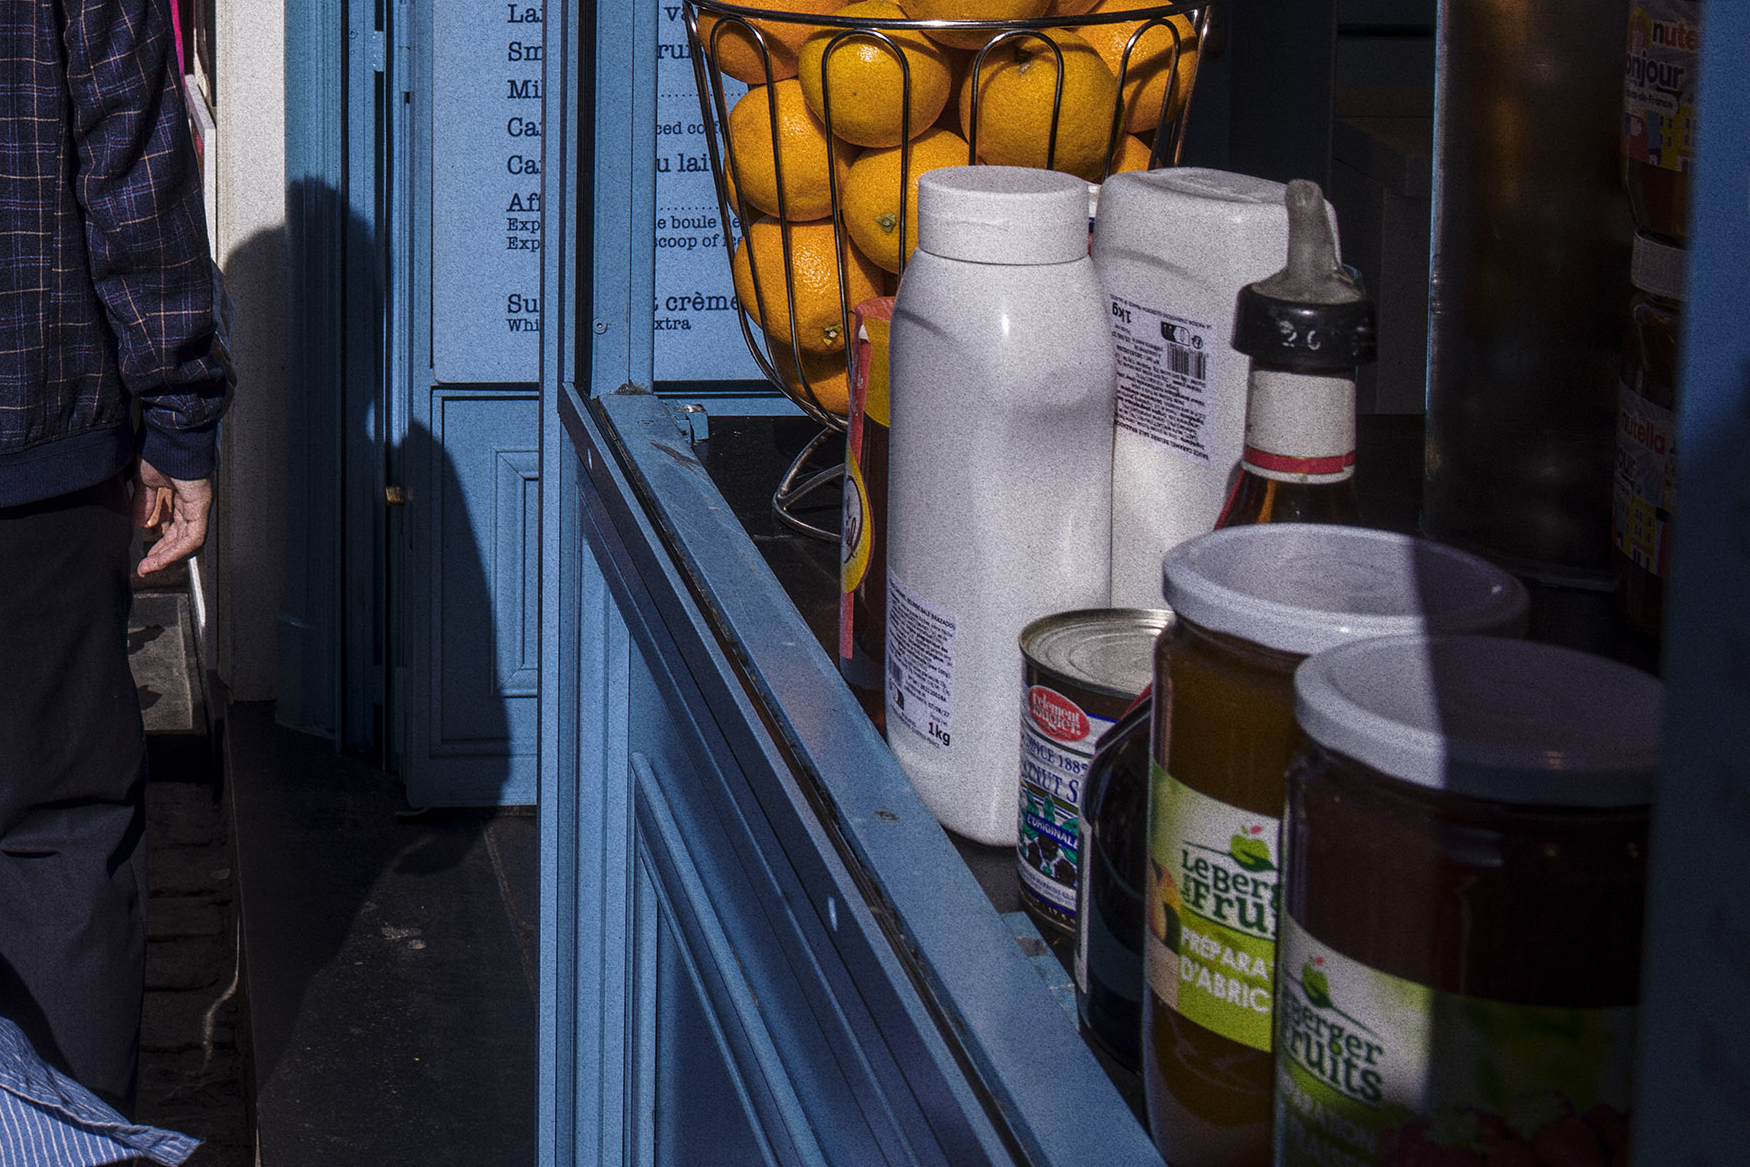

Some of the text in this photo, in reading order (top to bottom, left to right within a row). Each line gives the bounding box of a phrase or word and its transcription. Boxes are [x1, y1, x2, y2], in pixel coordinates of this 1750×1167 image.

[507, 4, 543, 23] La
[1626, 49, 1685, 89] onjour
[507, 80, 542, 99] Mi
[507, 117, 542, 137] Ca
[507, 155, 541, 175] Ca
[507, 218, 541, 233] Exp
[671, 216, 717, 229] boule
[507, 236, 541, 250] Exp
[702, 234, 719, 247] of
[508, 294, 540, 313] Su
[1112, 302, 1132, 324] 1kg
[507, 318, 691, 332] Whi xtra
[929, 720, 950, 748] 1kg
[1181, 849, 1208, 880] Le
[1192, 877, 1276, 935] Fru
[1181, 924, 1276, 982] PRÉPARA
[1180, 954, 1271, 1015] D'ABRIC
